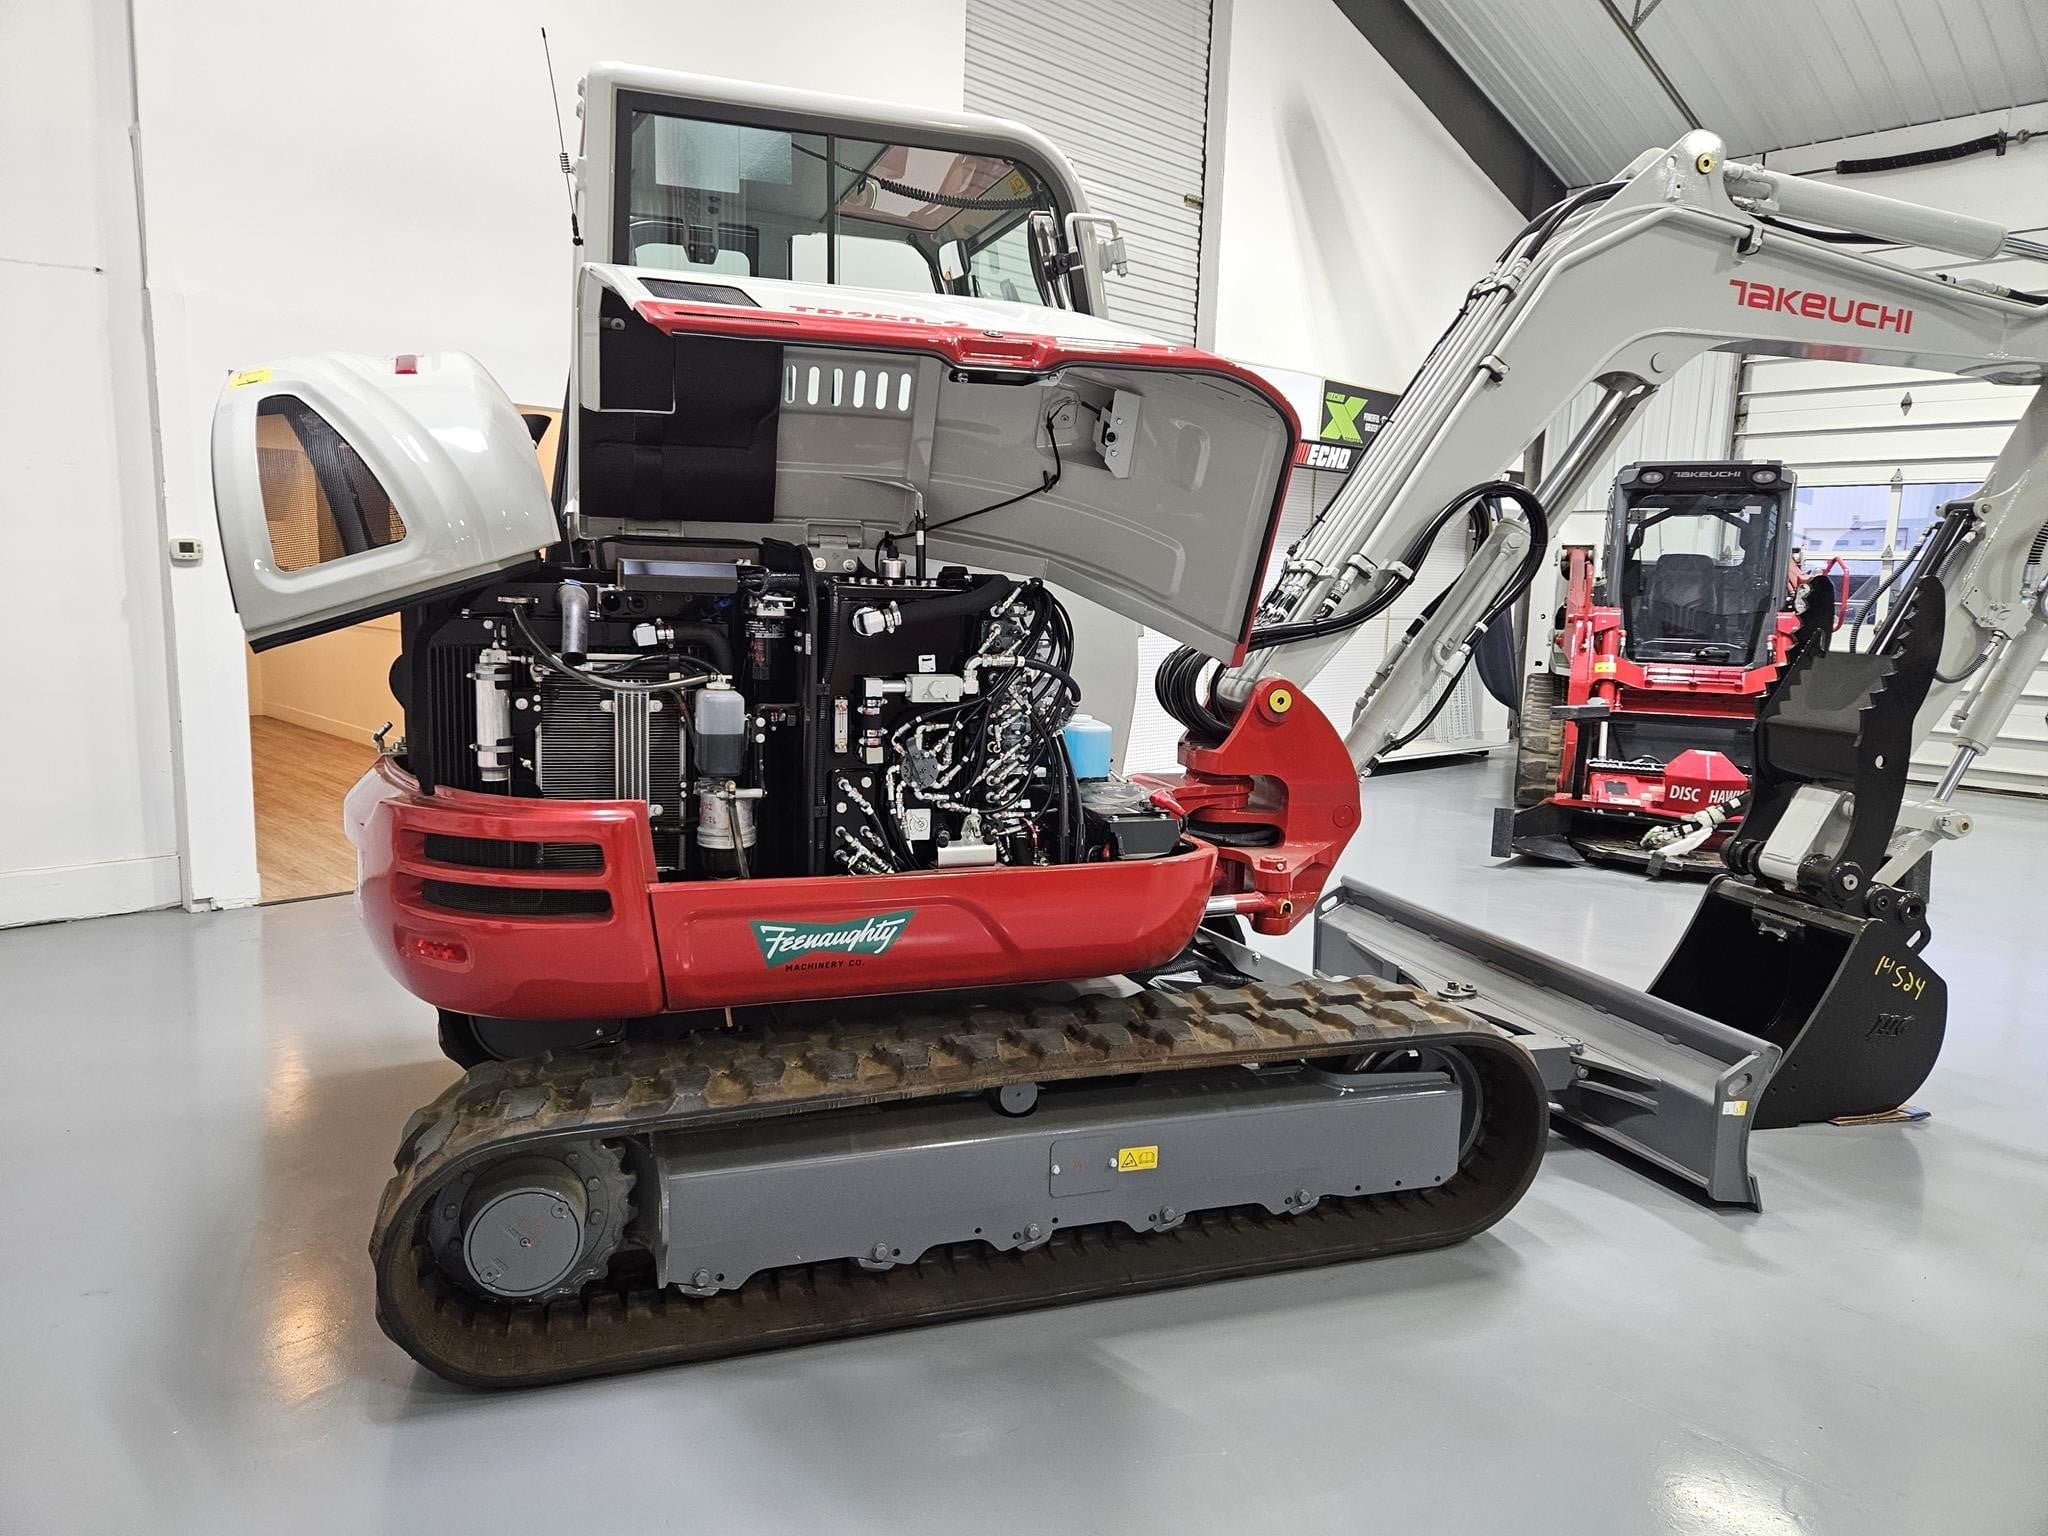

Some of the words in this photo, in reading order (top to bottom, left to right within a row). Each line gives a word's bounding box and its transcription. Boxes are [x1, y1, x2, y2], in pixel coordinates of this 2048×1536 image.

[1306, 443, 1352, 470] ECHO
[1669, 784, 1701, 803] DISC
[760, 917, 906, 960] Feenaughty
[785, 960, 844, 972] MACHINERY
[848, 959, 865, 968] CO.
